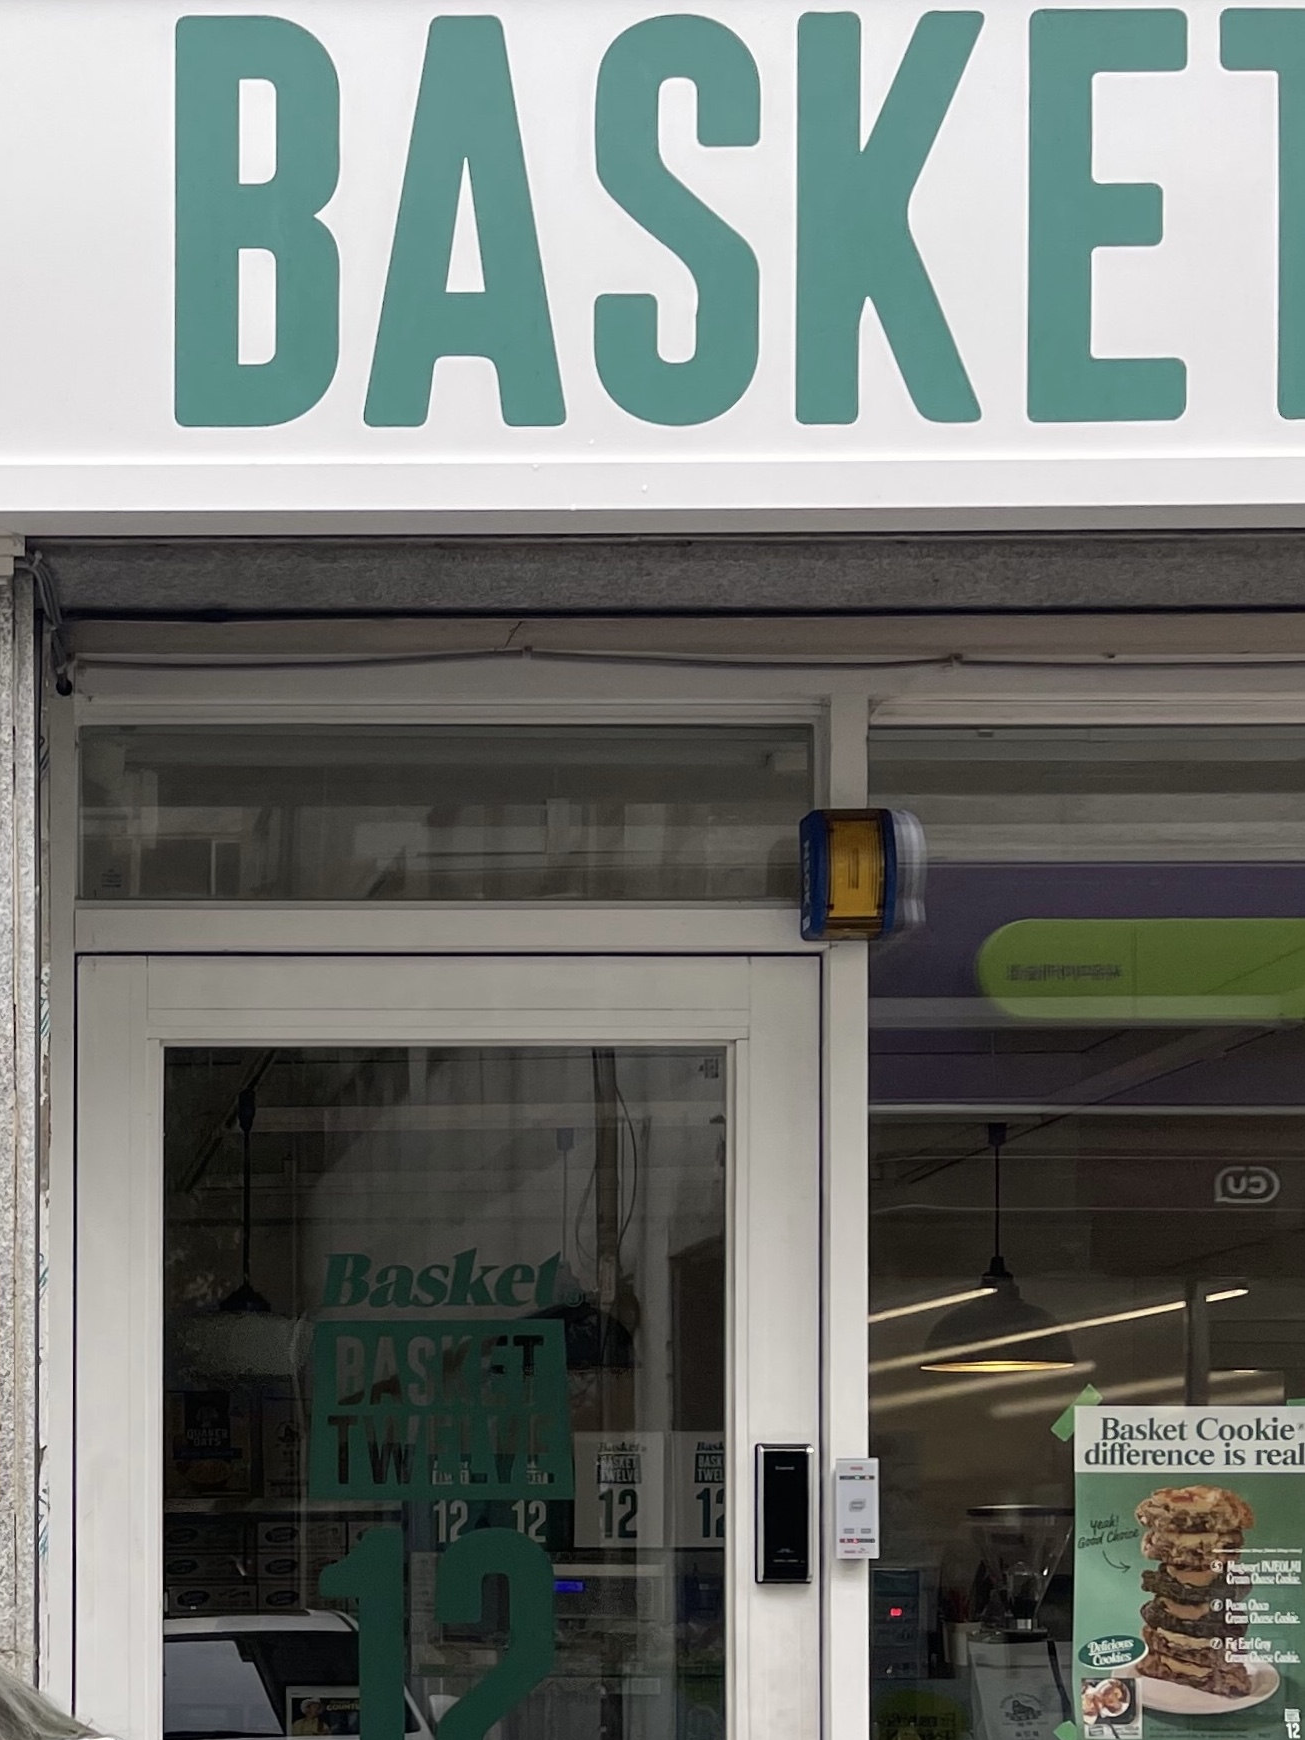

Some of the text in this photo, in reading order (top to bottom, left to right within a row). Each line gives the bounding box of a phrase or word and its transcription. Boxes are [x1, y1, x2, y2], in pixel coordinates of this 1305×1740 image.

[321, 1247, 561, 1308] Basket
[336, 1335, 544, 1406] BASKET
[328, 1415, 555, 1485] TWELVE
[1101, 1417, 1295, 1441] Basket Cookie
[1084, 1442, 1305, 1466] difference is real
[433, 1499, 468, 1542] 12
[512, 1499, 546, 1542] 12
[599, 1488, 637, 1538] 12
[1087, 1639, 1134, 1654] Delicious
[1092, 1652, 1132, 1666] Cookies
[1286, 1723, 1301, 1739] 12
